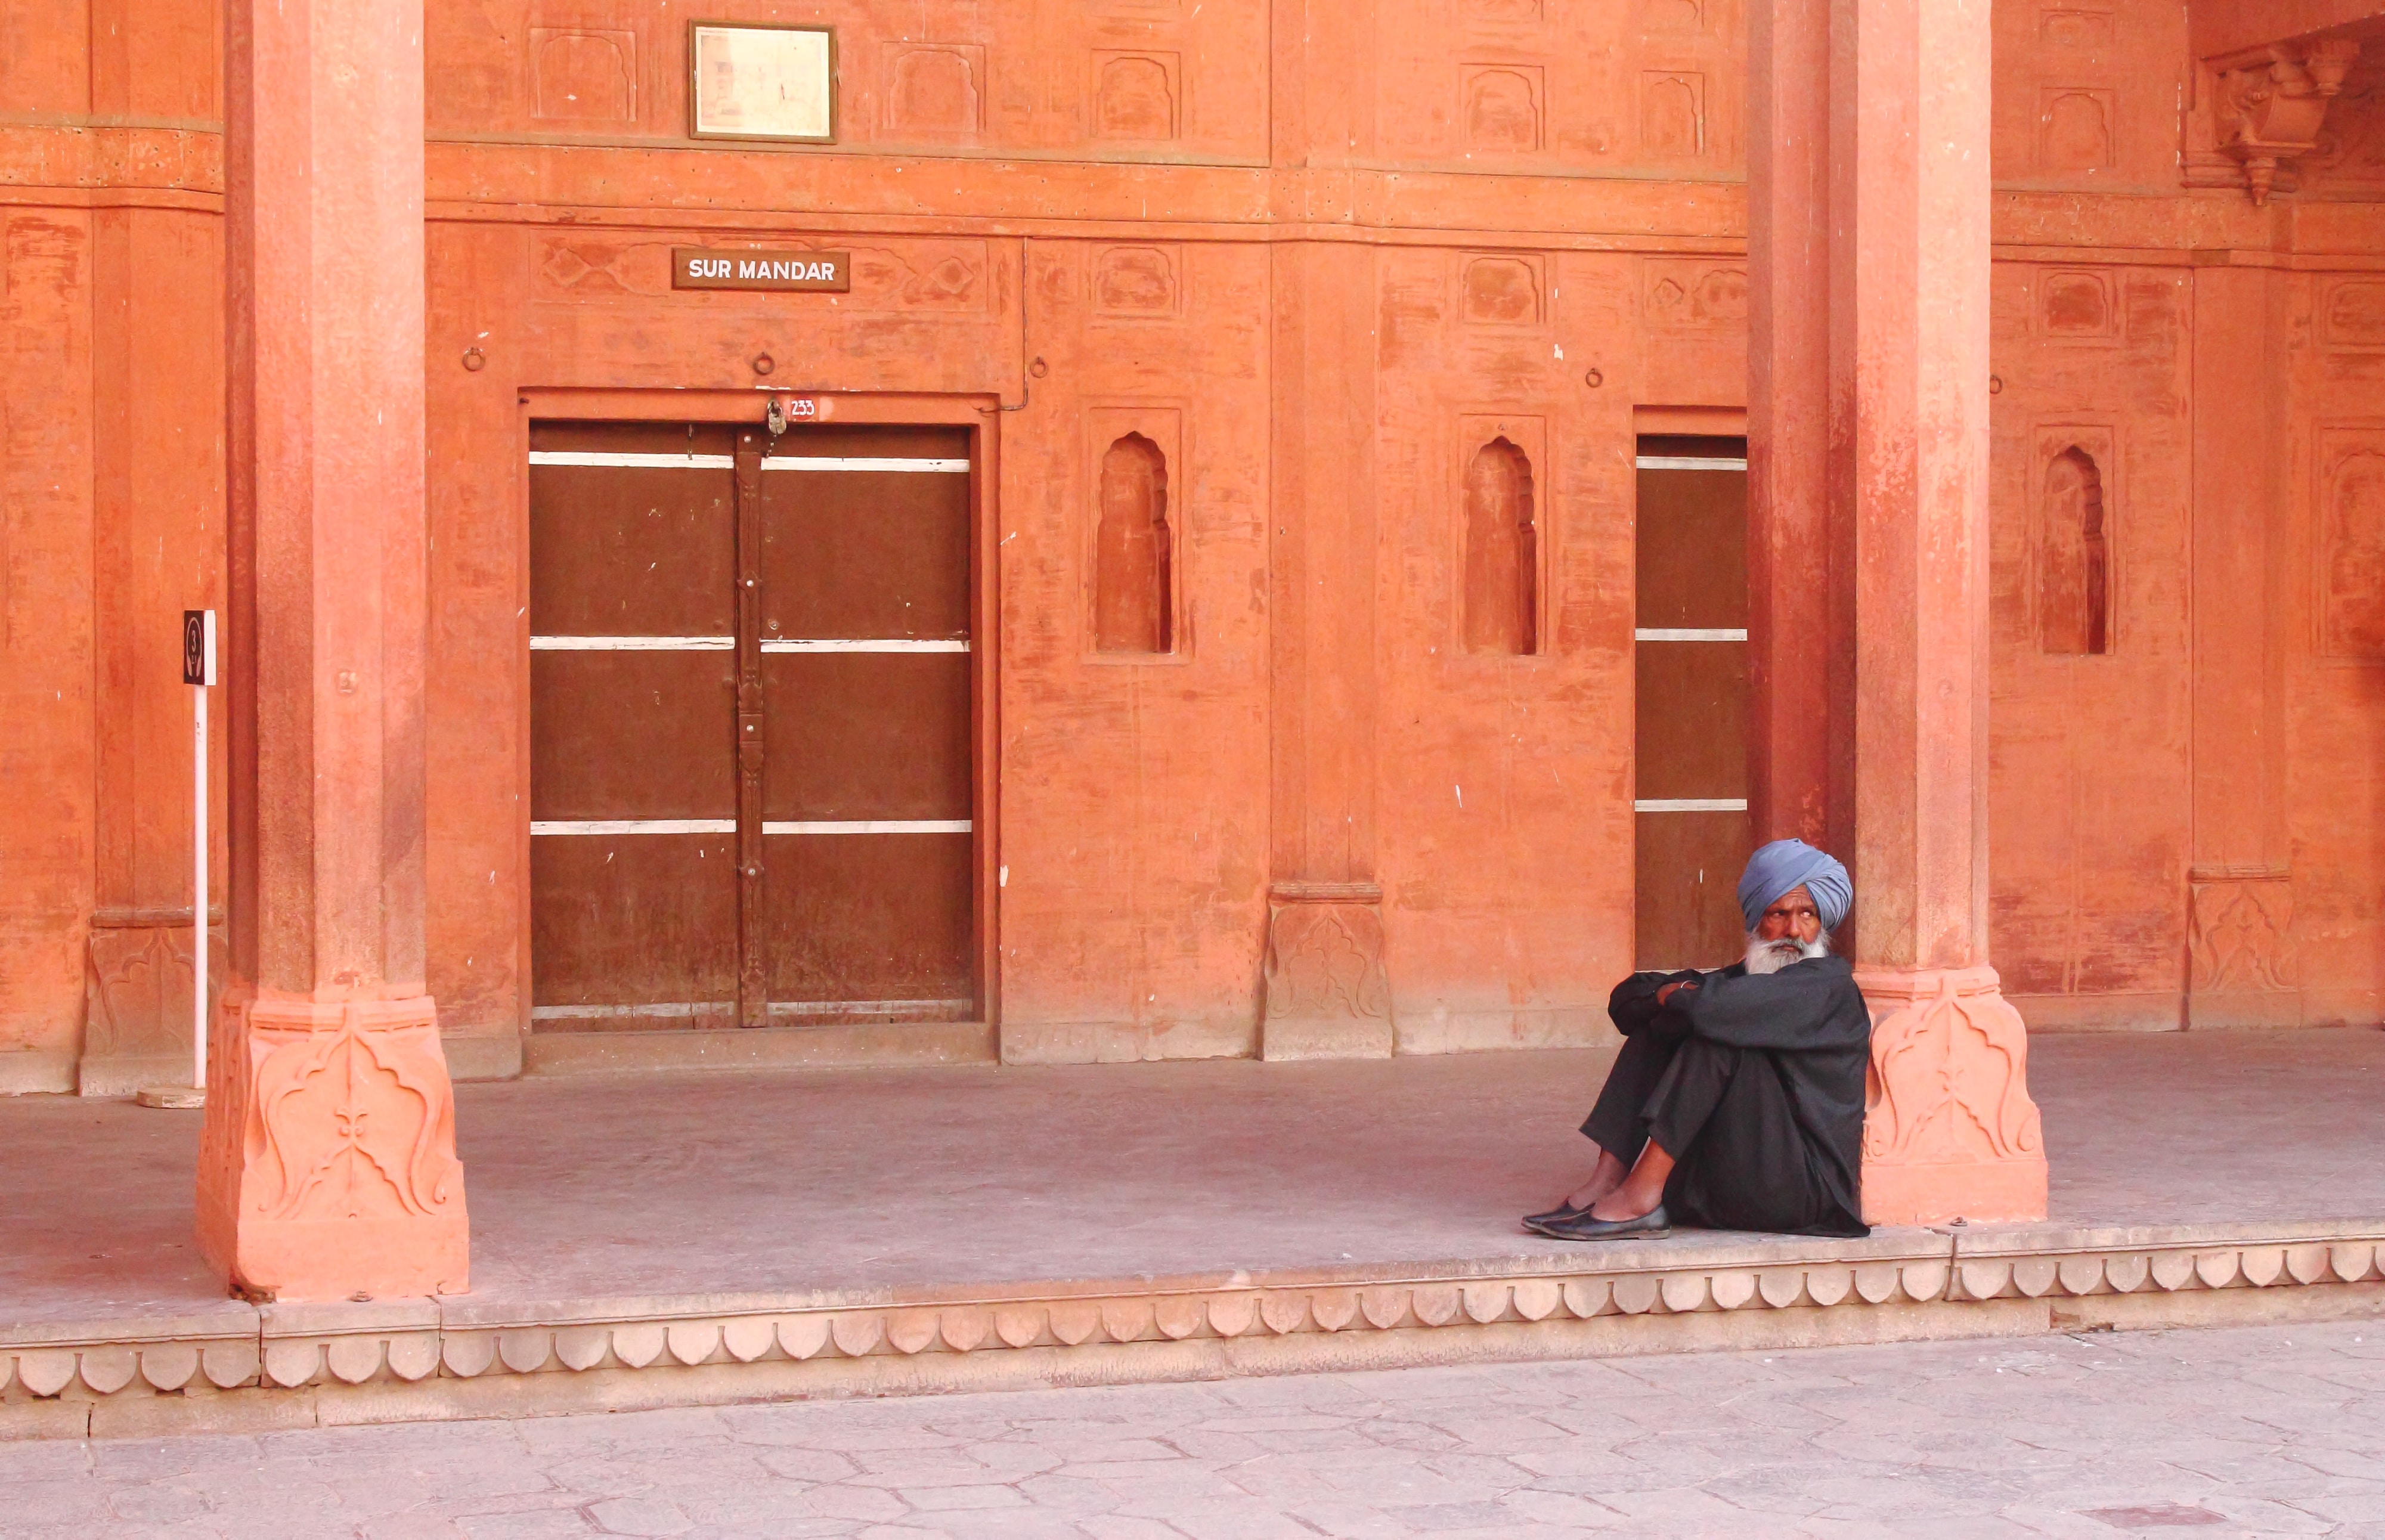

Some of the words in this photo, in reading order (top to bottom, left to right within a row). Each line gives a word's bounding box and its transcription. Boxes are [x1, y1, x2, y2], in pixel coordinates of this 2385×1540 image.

[689, 259, 732, 278] SUR
[739, 260, 835, 281] MANDAR
[791, 399, 815, 416] 233
[191, 630, 196, 652] 3
